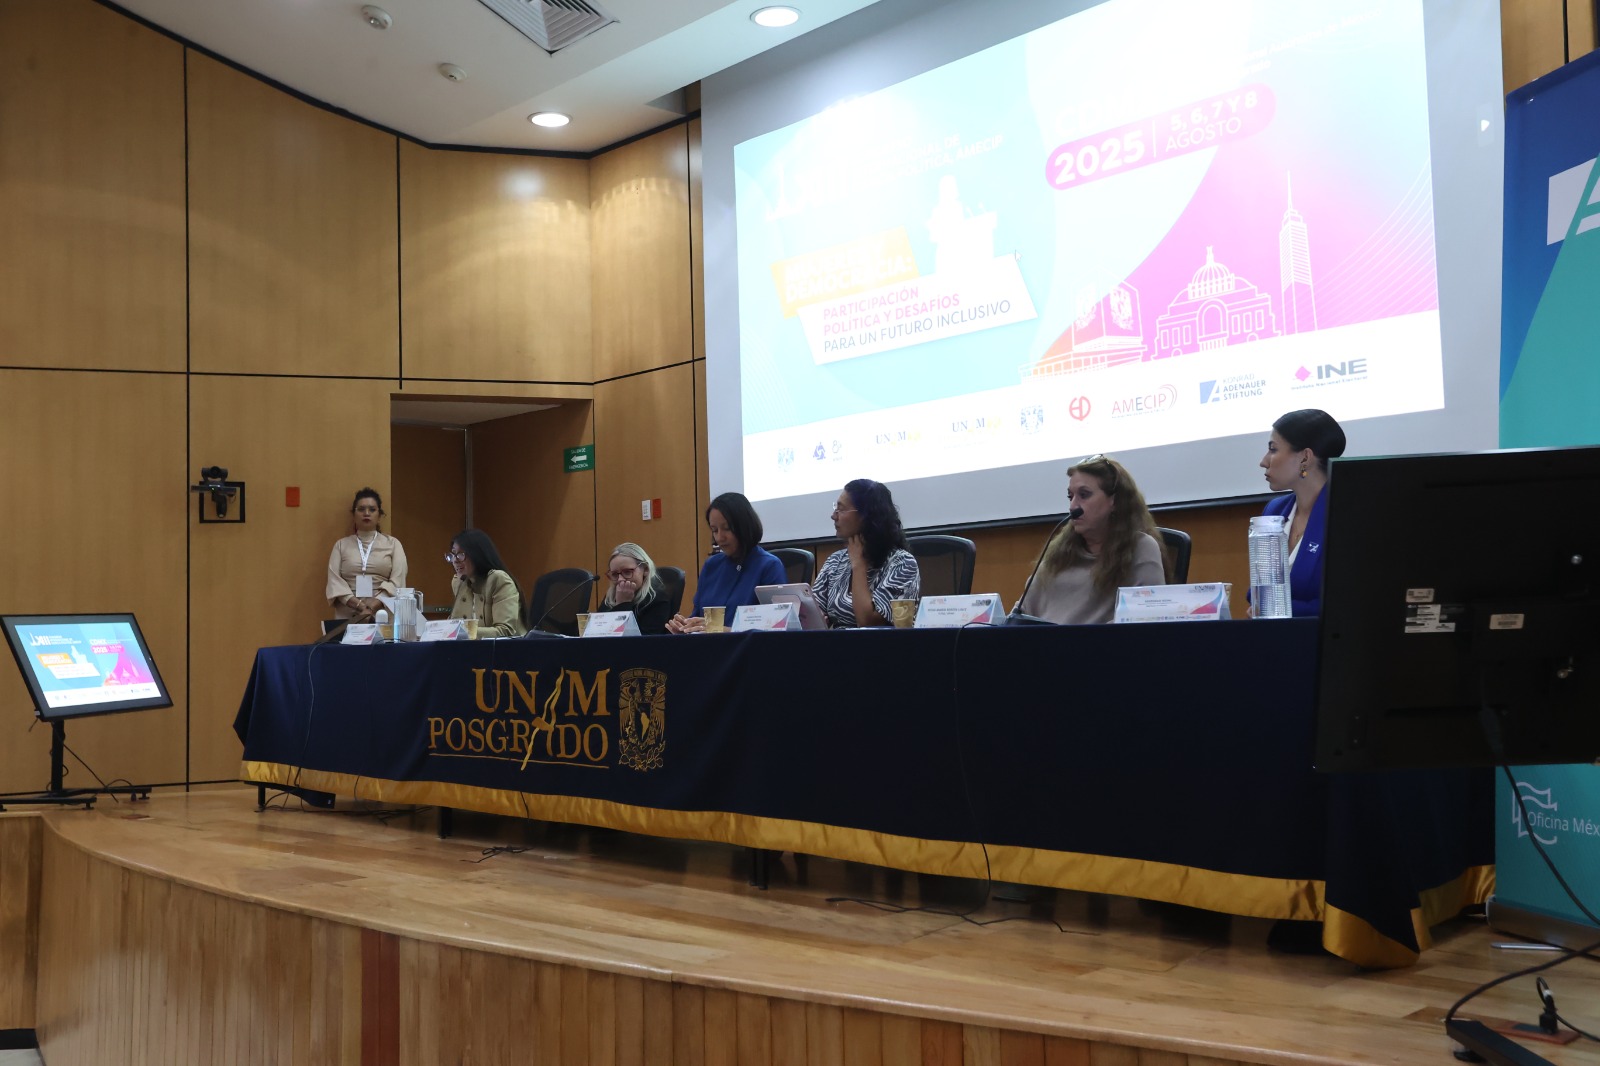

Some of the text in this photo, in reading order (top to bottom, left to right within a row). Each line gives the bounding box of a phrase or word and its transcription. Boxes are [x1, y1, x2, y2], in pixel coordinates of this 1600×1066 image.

[1170, 91, 1258, 132] 5, 6, 7 Y 8
[943, 134, 960, 150] DE
[1165, 116, 1242, 153] AGOSTO
[955, 134, 1003, 161] AMECIP
[1054, 130, 1145, 185] 2025
[823, 285, 920, 320] PARTICIPACIÓN
[823, 293, 960, 336] POLÍTICA Y DESAFÍOS
[824, 299, 1011, 353] PARA UN FUTURO INCLUSIVO
[1222, 373, 1255, 385] KONRAD
[1316, 358, 1368, 380] INE
[1222, 379, 1267, 394] ADENAUER
[1222, 389, 1264, 402] STIFTUNG
[1111, 394, 1167, 416] AMECIP
[951, 417, 986, 433] UNM
[1528, 811, 1569, 831] Oficina
